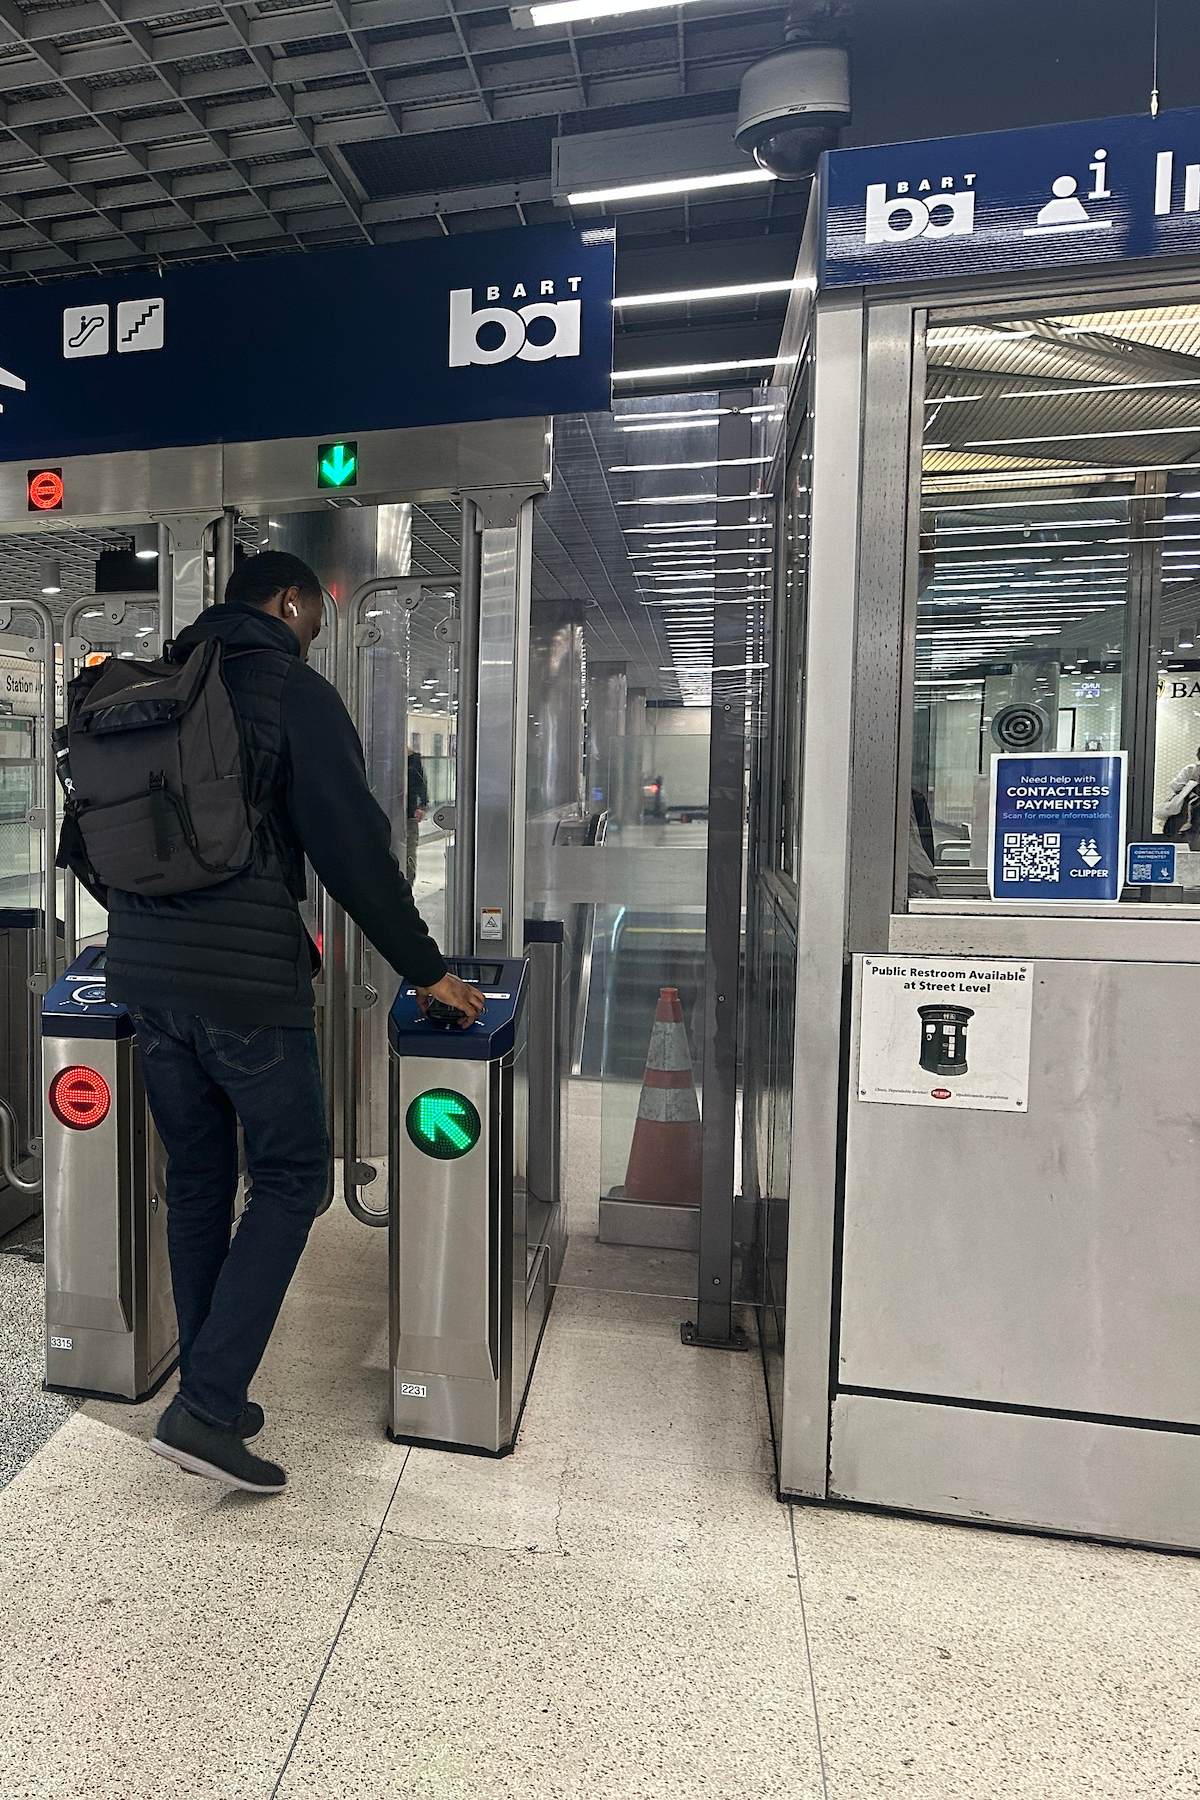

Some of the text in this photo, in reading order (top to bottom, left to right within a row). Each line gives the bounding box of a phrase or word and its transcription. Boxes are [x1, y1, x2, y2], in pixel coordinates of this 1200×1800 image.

[897, 173, 976, 193] BART
[486, 277, 582, 301] BART
[6, 675, 34, 693] Station
[1020, 775, 1096, 785] Need help with
[1006, 786, 1110, 797] CONTACTLESS
[1016, 800, 1100, 810] PAYMENTS?
[1061, 811, 1113, 819] information.
[1069, 868, 1109, 878] CLIPPER
[871, 966, 1026, 981] Public Restroom Available
[903, 981, 991, 993] at Street Level
[51, 1338, 72, 1348] 3315
[402, 1384, 426, 1396] 2231
